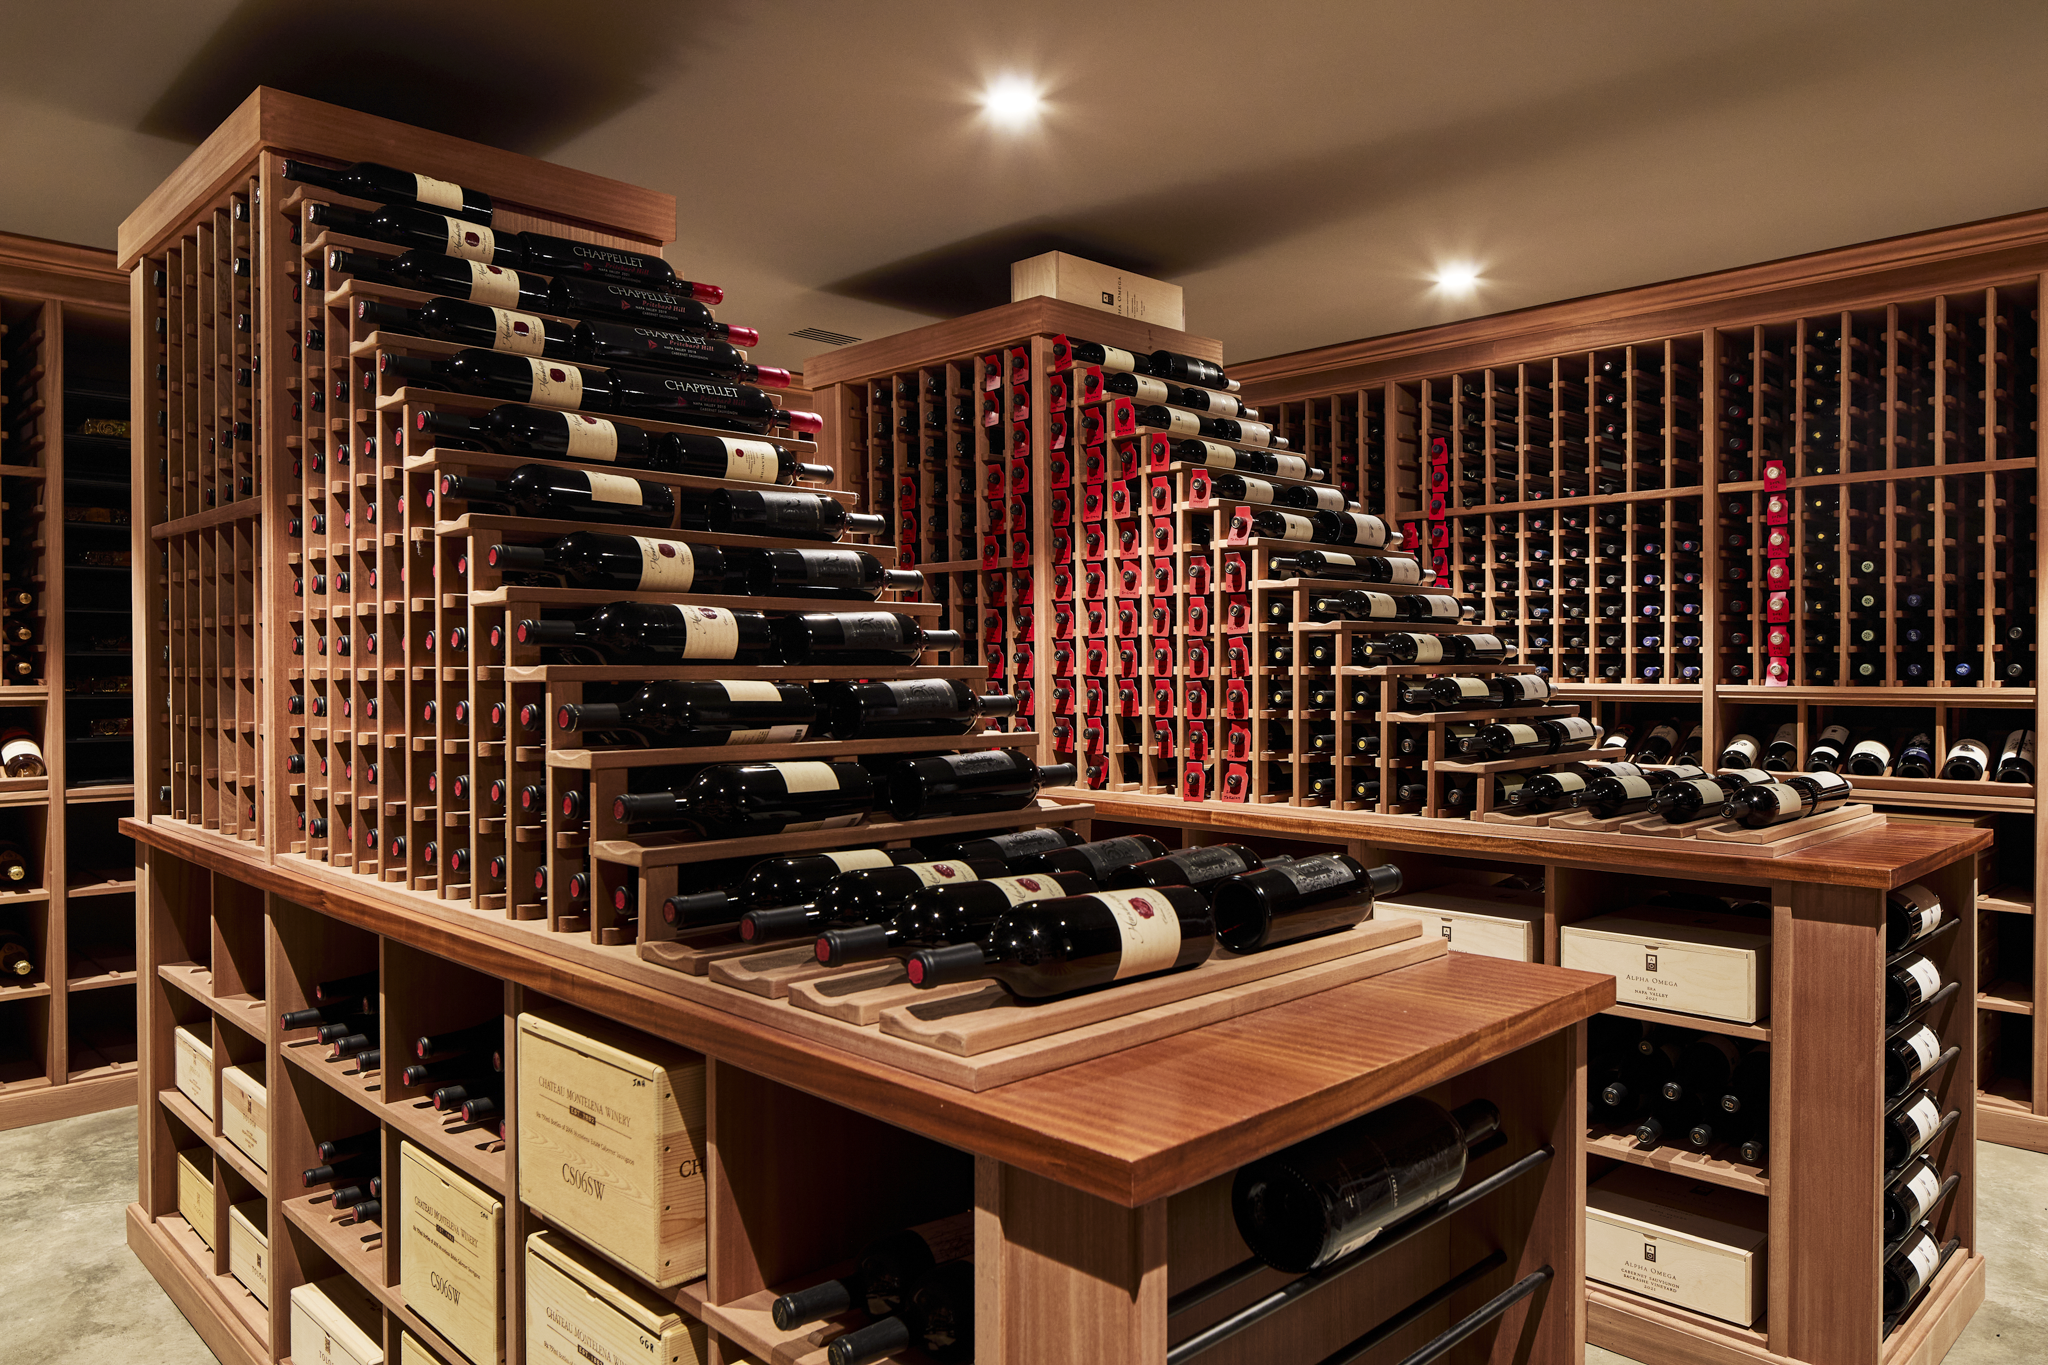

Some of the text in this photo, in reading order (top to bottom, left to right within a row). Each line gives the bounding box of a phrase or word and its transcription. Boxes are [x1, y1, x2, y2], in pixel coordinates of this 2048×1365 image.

[573, 246, 643, 268] CHAPPELLET
[608, 285, 677, 305] CHAPPELLET
[642, 300, 672, 310] Pritchard
[634, 328, 706, 346] CHAPPELLET
[669, 340, 700, 349] Pritchard
[664, 380, 738, 398] CHAPPELLET
[1626, 974, 1678, 987] ALPHA OMEGA
[538, 1075, 631, 1128] CHATEAU MONTELENA WINERY
[562, 1163, 605, 1201] CS06SW
[460, 1227, 478, 1248] WINERY
[1621, 1268, 1680, 1289] CABERNET SAUVIGNON
[1625, 1260, 1677, 1280] ALPHA OMEGA
[431, 1270, 461, 1306] CS06SW
[1650, 1282, 1677, 1293] VINEYARD
[574, 1326, 611, 1363] MONTELENA
